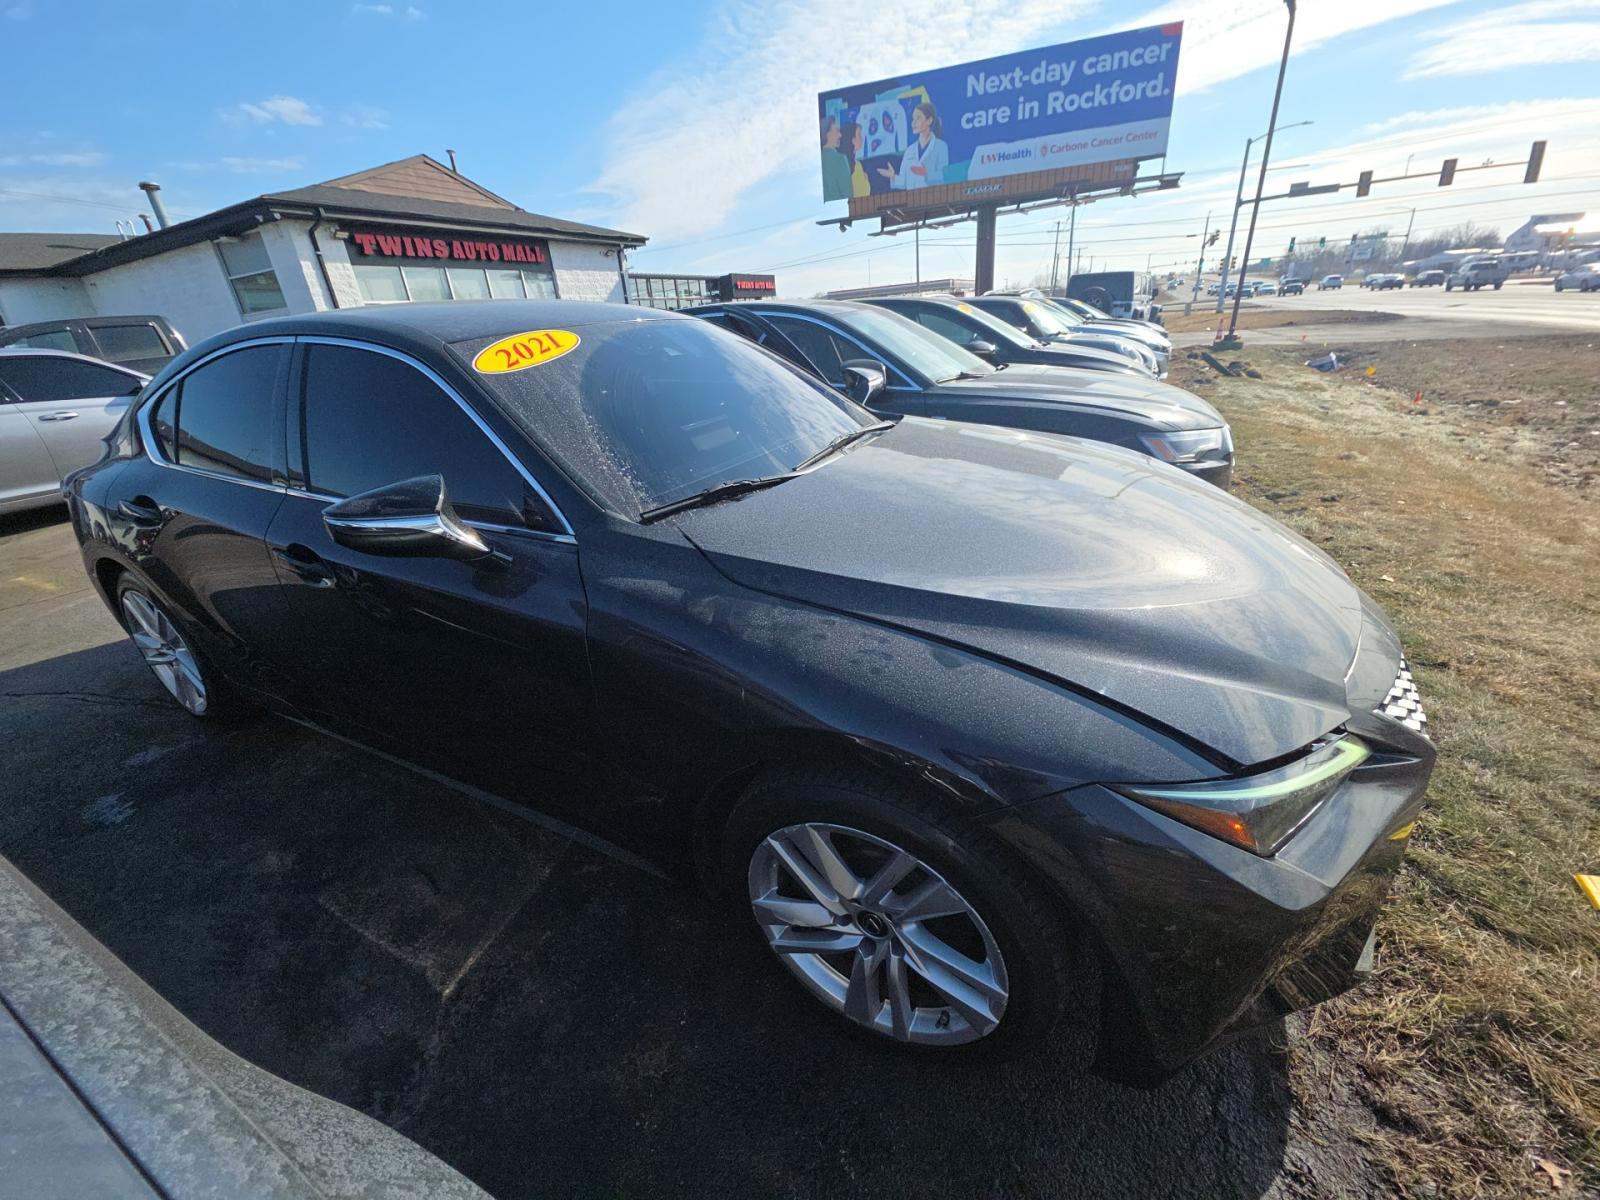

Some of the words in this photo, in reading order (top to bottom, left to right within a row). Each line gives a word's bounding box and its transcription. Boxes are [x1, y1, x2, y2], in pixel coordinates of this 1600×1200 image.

[966, 59, 1076, 98] Next-day
[1082, 42, 1173, 76] cancer
[960, 105, 1011, 130] care
[1017, 96, 1040, 121] in
[1046, 72, 1170, 116] Rockford.
[1050, 141, 1089, 154] Carbone
[1090, 135, 1123, 148] Cancer
[1125, 129, 1159, 143] Center
[354, 233, 449, 259] TWINS
[452, 240, 499, 261] AUTO
[502, 244, 546, 263] MALL
[495, 333, 564, 369] 2021
